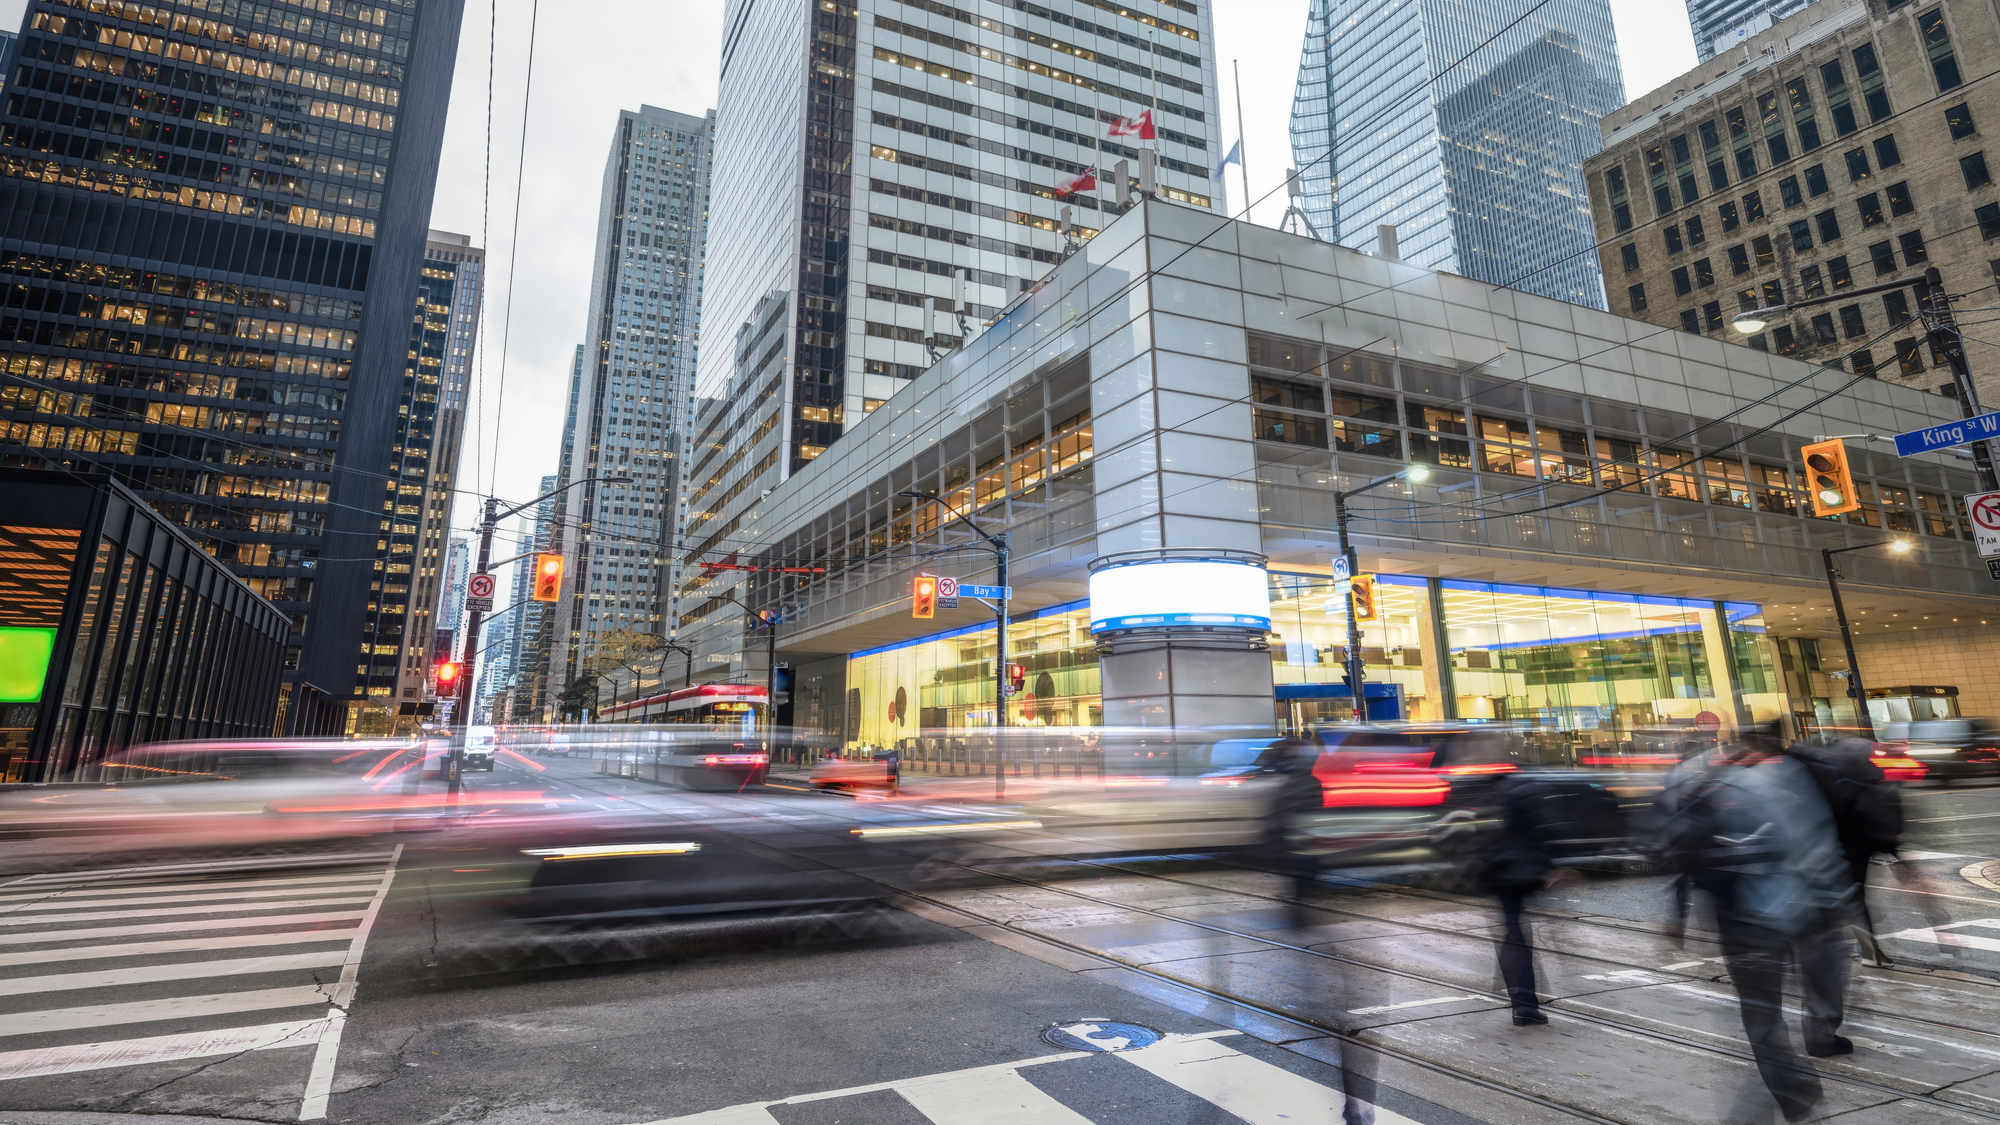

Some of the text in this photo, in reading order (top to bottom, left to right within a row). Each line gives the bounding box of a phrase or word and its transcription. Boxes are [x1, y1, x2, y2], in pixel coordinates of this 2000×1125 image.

[1922, 415, 1997, 446] King St W
[1978, 537, 1984, 545] 7
[974, 586, 989, 597] Bay
